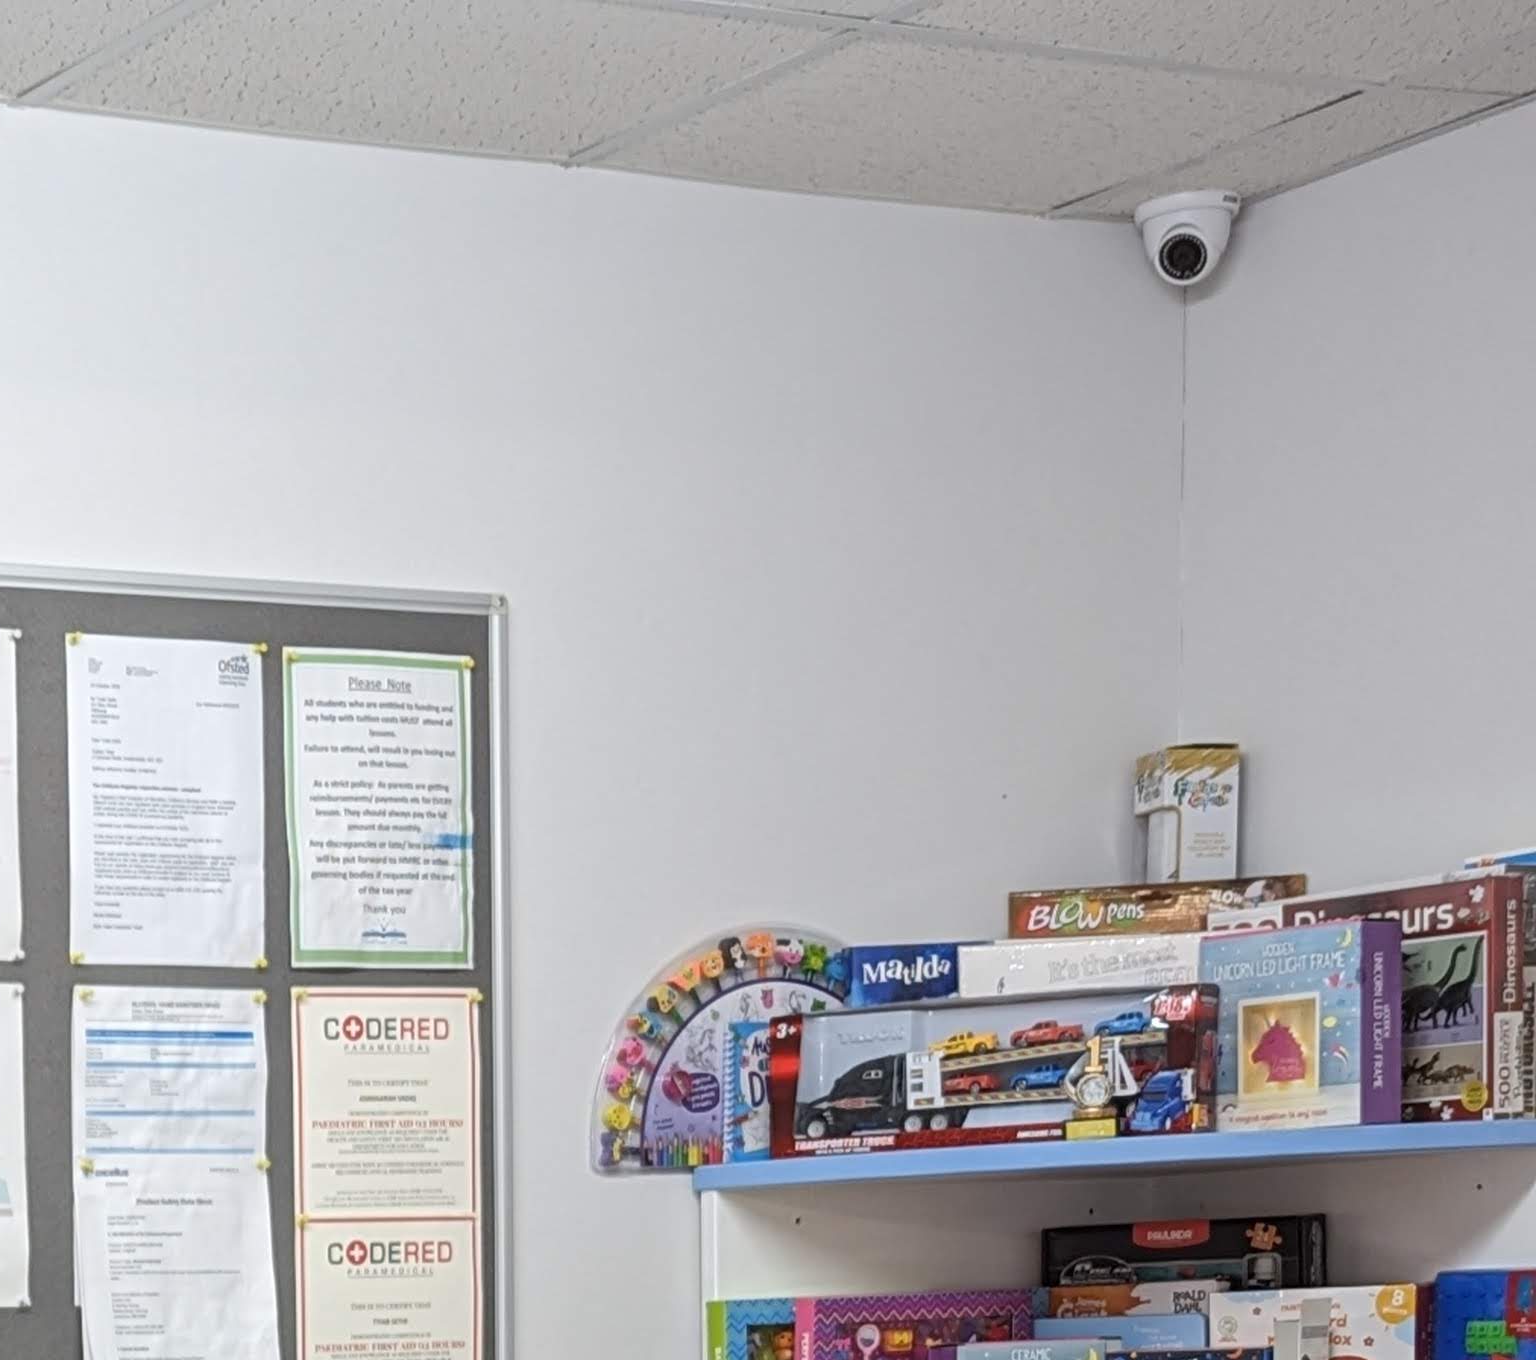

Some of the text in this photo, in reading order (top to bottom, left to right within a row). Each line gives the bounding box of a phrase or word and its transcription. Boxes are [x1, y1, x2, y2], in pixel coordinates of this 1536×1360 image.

[218, 659, 250, 675] Ofsted
[348, 676, 412, 693] Please Note
[316, 699, 347, 708] students
[362, 903, 407, 916] Thank you
[1106, 902, 1146, 924] pens
[1503, 898, 1516, 1004] Dinosaurs
[861, 952, 952, 987] Matilda
[1213, 961, 1256, 982] UNICORN
[1257, 958, 1276, 978] LED
[1277, 954, 1308, 975] LIGHT
[1310, 950, 1347, 972] FRAME
[775, 1022, 797, 1040] 3+
[794, 1136, 860, 1152] TRANSPORTER
[861, 1134, 896, 1148] TRUCK
[1172, 1290, 1206, 1304] ROALD
[1391, 1289, 1404, 1307] 8
[1173, 1302, 1203, 1315] DAHL
